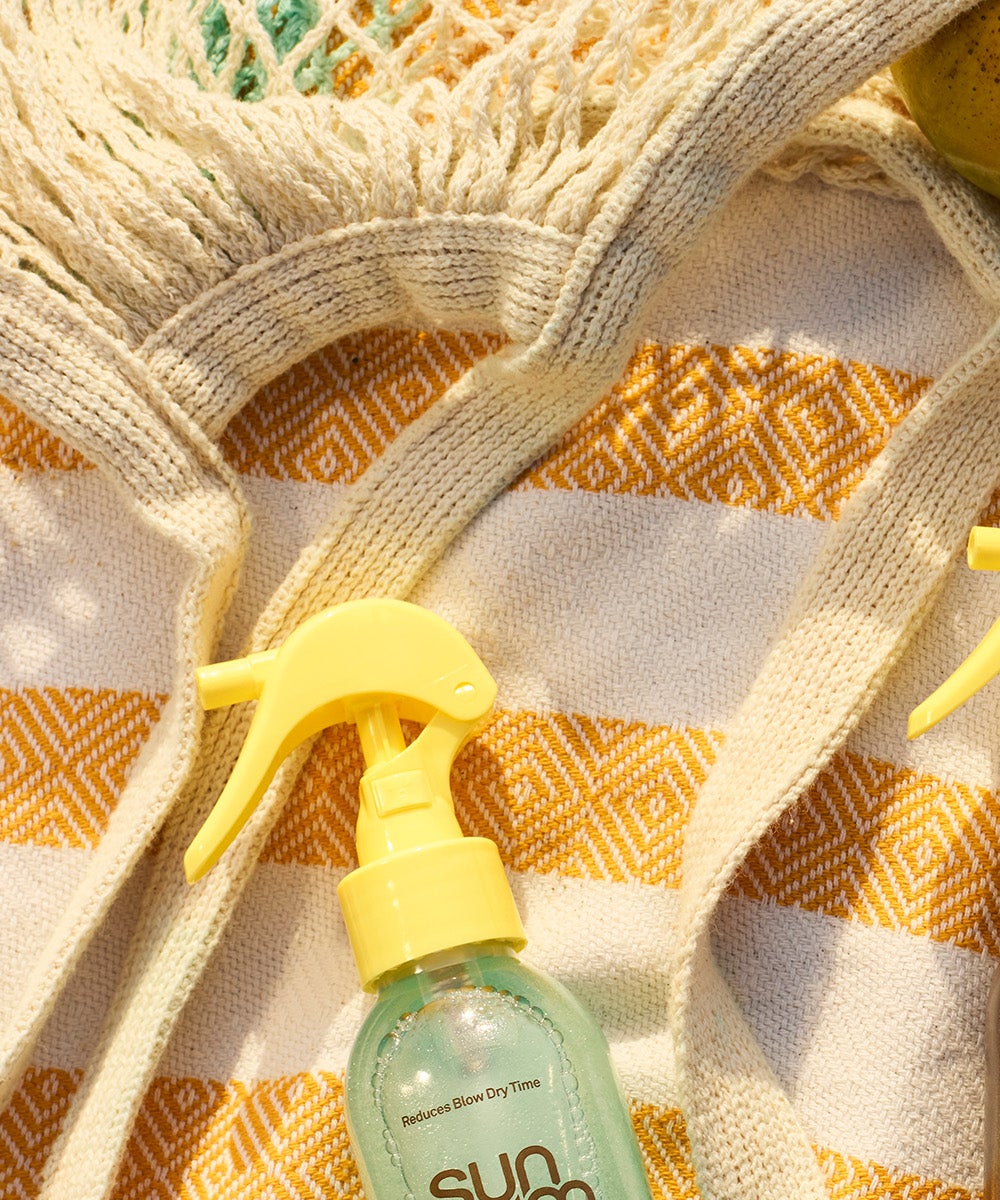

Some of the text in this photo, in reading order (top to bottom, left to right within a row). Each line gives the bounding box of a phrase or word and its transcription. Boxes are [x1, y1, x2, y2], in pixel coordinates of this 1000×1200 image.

[401, 1078, 540, 1127] Reduces Blow Dry Time
